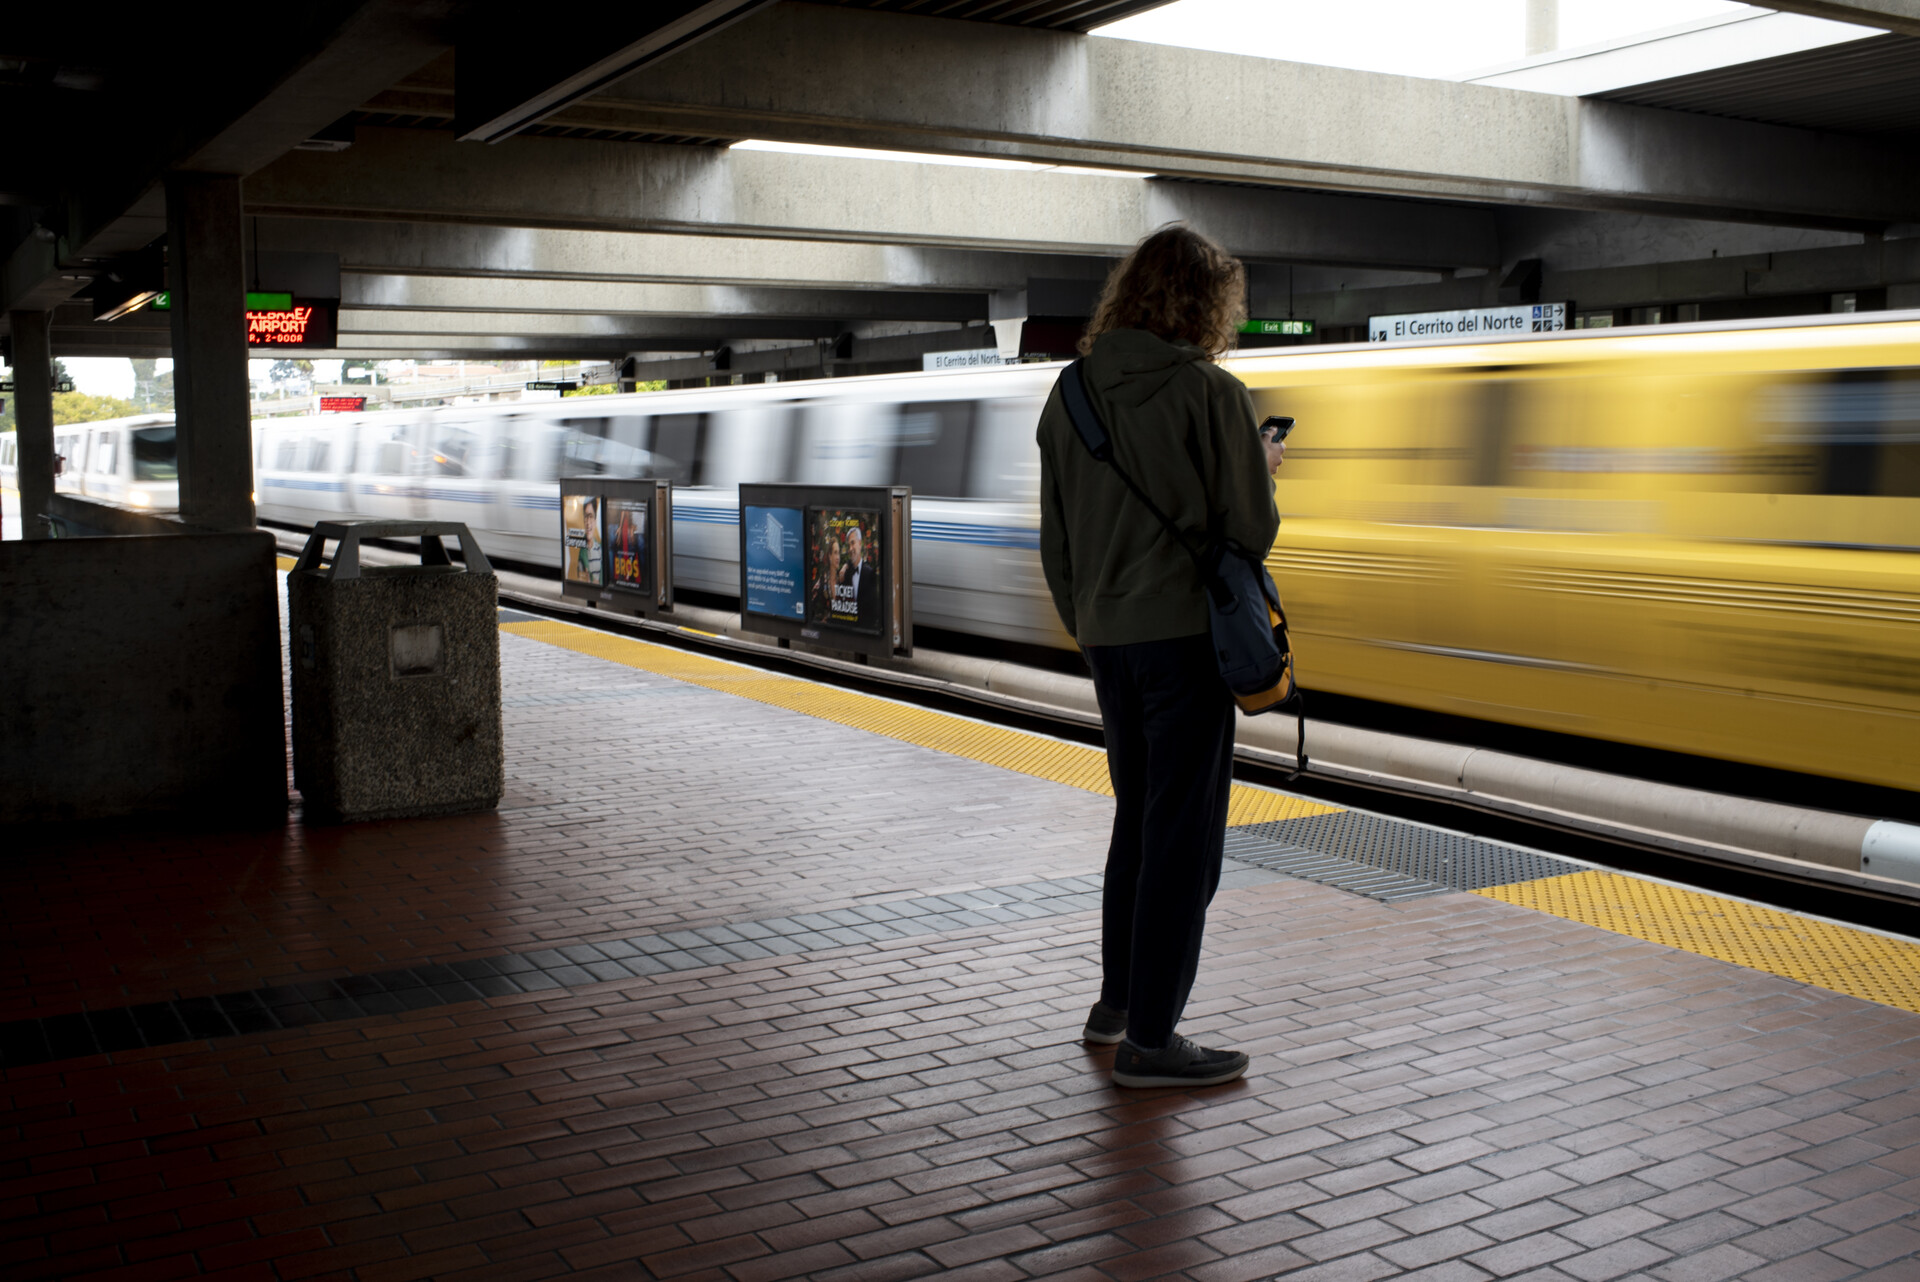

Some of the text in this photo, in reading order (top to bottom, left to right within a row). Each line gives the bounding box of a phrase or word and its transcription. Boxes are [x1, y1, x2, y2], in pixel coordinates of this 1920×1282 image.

[248, 319, 307, 333] AIRPORT
[1264, 323, 1279, 332] Exit
[1394, 315, 1524, 336] El Cerrito del Norte
[936, 354, 1001, 367] El Cerrito del Norte
[615, 557, 639, 578] BROS
[834, 584, 854, 598] TICKET
[831, 599, 858, 615] PARADISE
